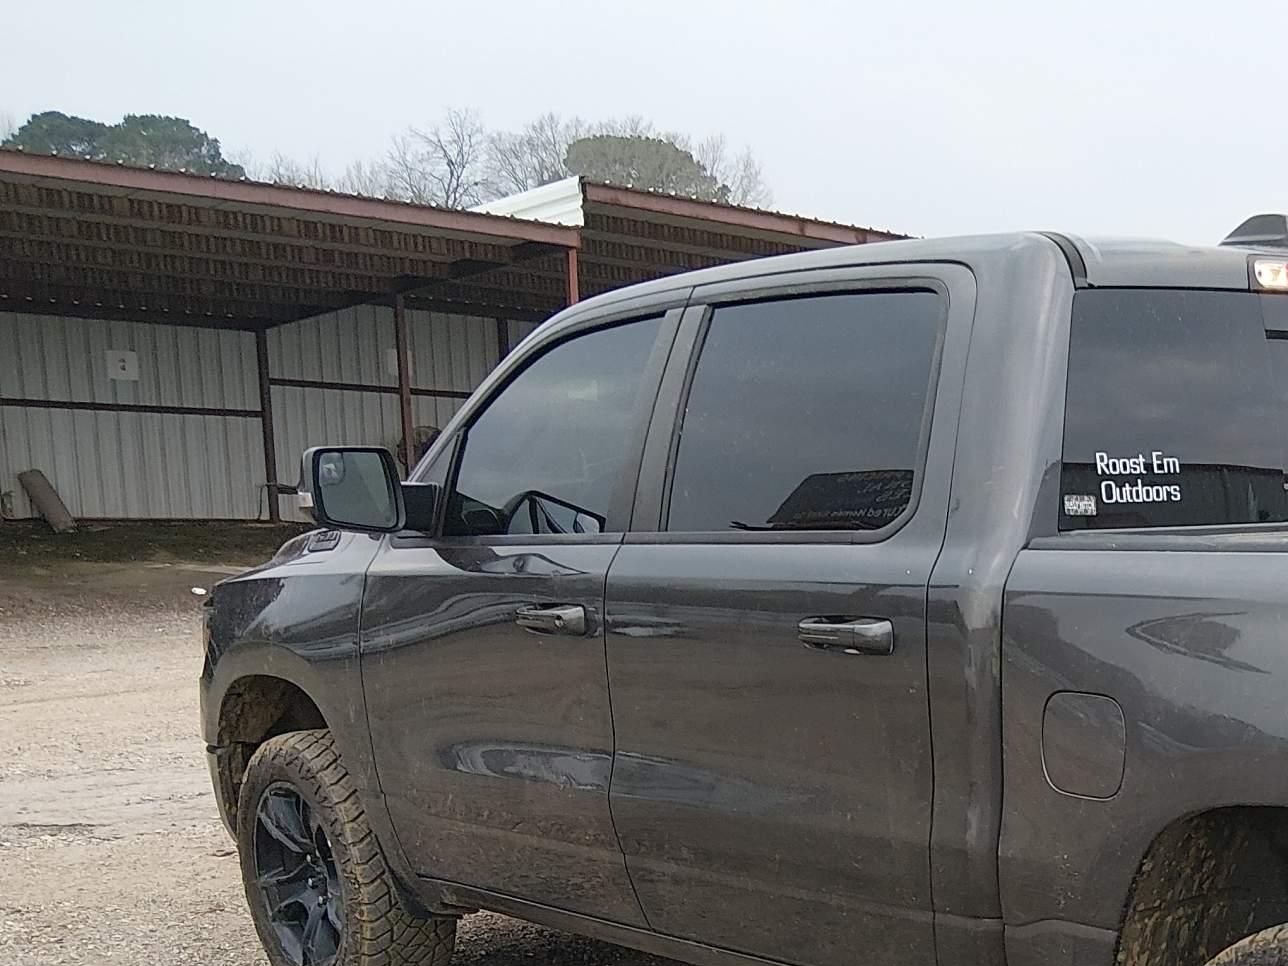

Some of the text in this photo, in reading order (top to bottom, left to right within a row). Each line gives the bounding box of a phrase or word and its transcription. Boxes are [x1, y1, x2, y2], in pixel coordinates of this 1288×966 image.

[1095, 451, 1180, 475] Roost Em
[1101, 478, 1181, 503] Outdoors
